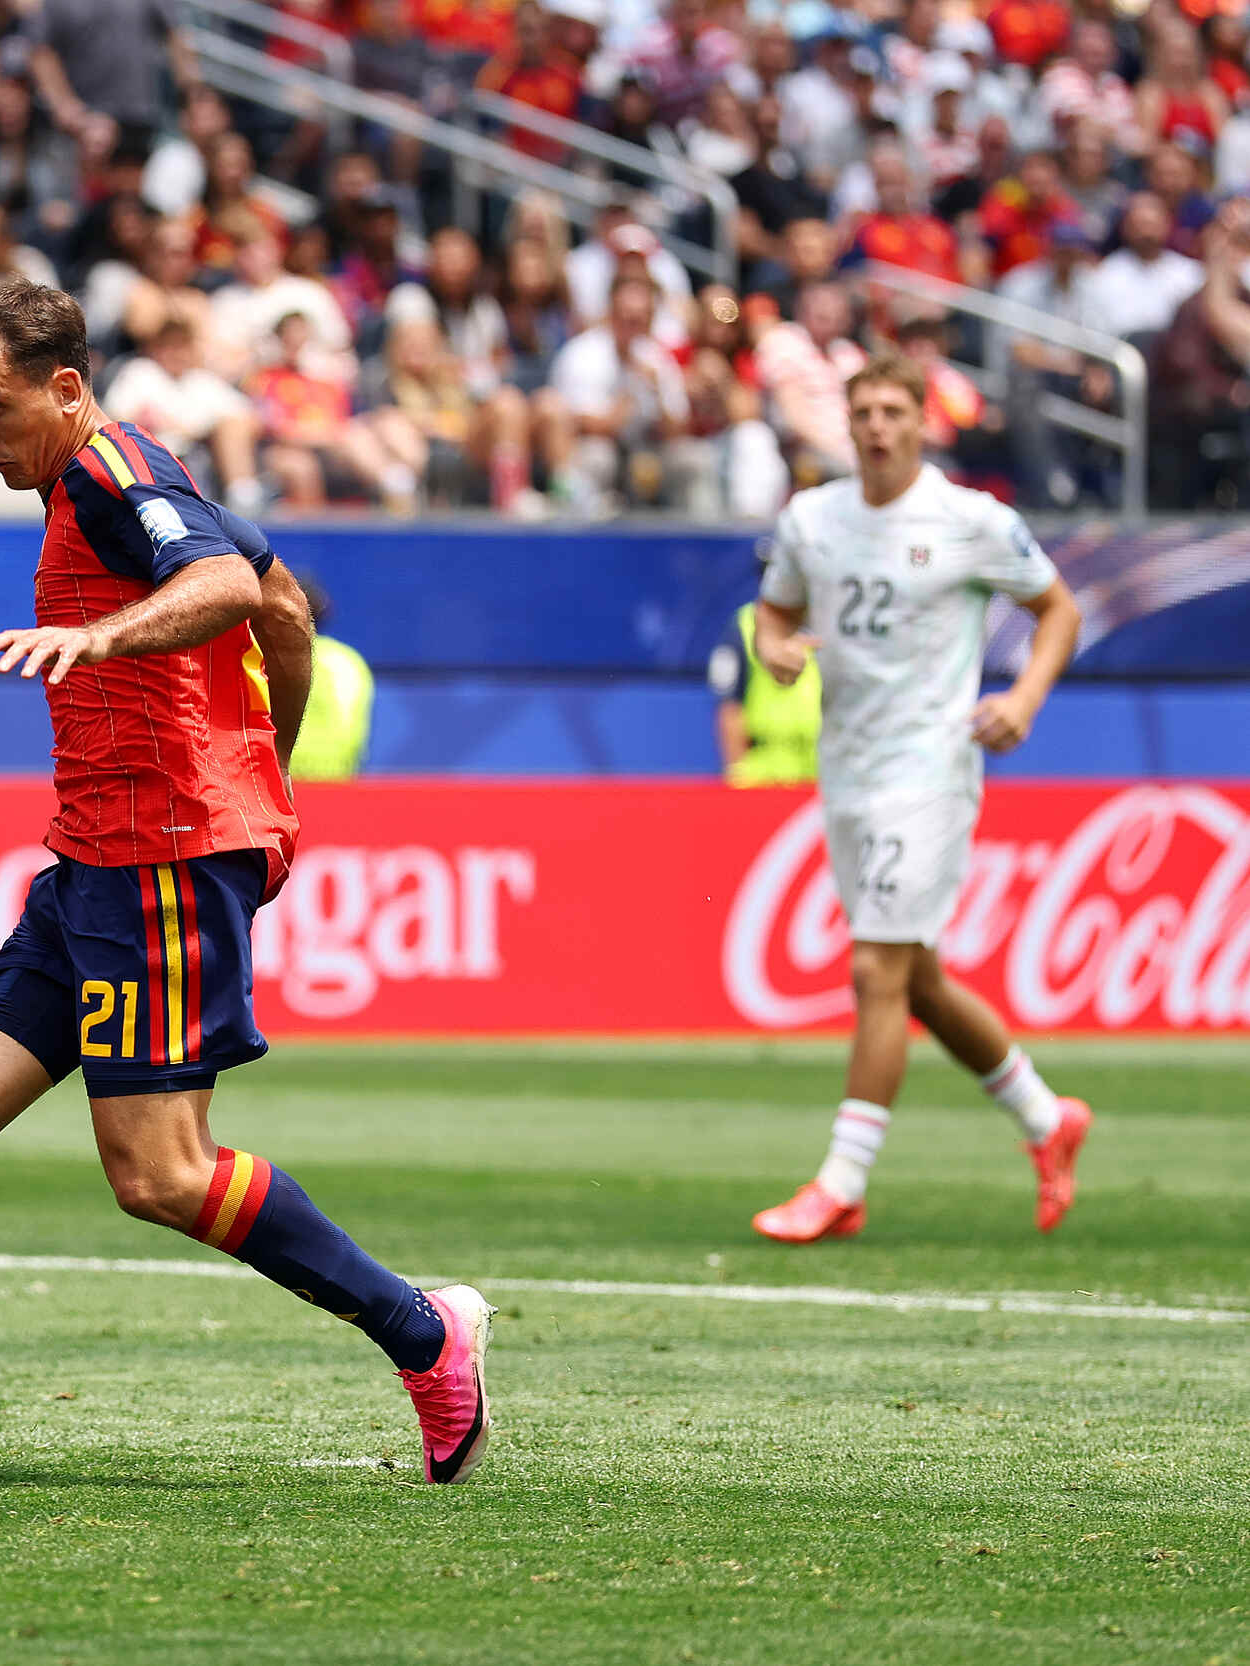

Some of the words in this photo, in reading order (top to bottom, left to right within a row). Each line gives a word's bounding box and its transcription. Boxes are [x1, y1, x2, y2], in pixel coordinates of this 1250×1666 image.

[838, 575, 894, 638] 22
[251, 846, 535, 1018] gar
[81, 980, 138, 1058] 21
